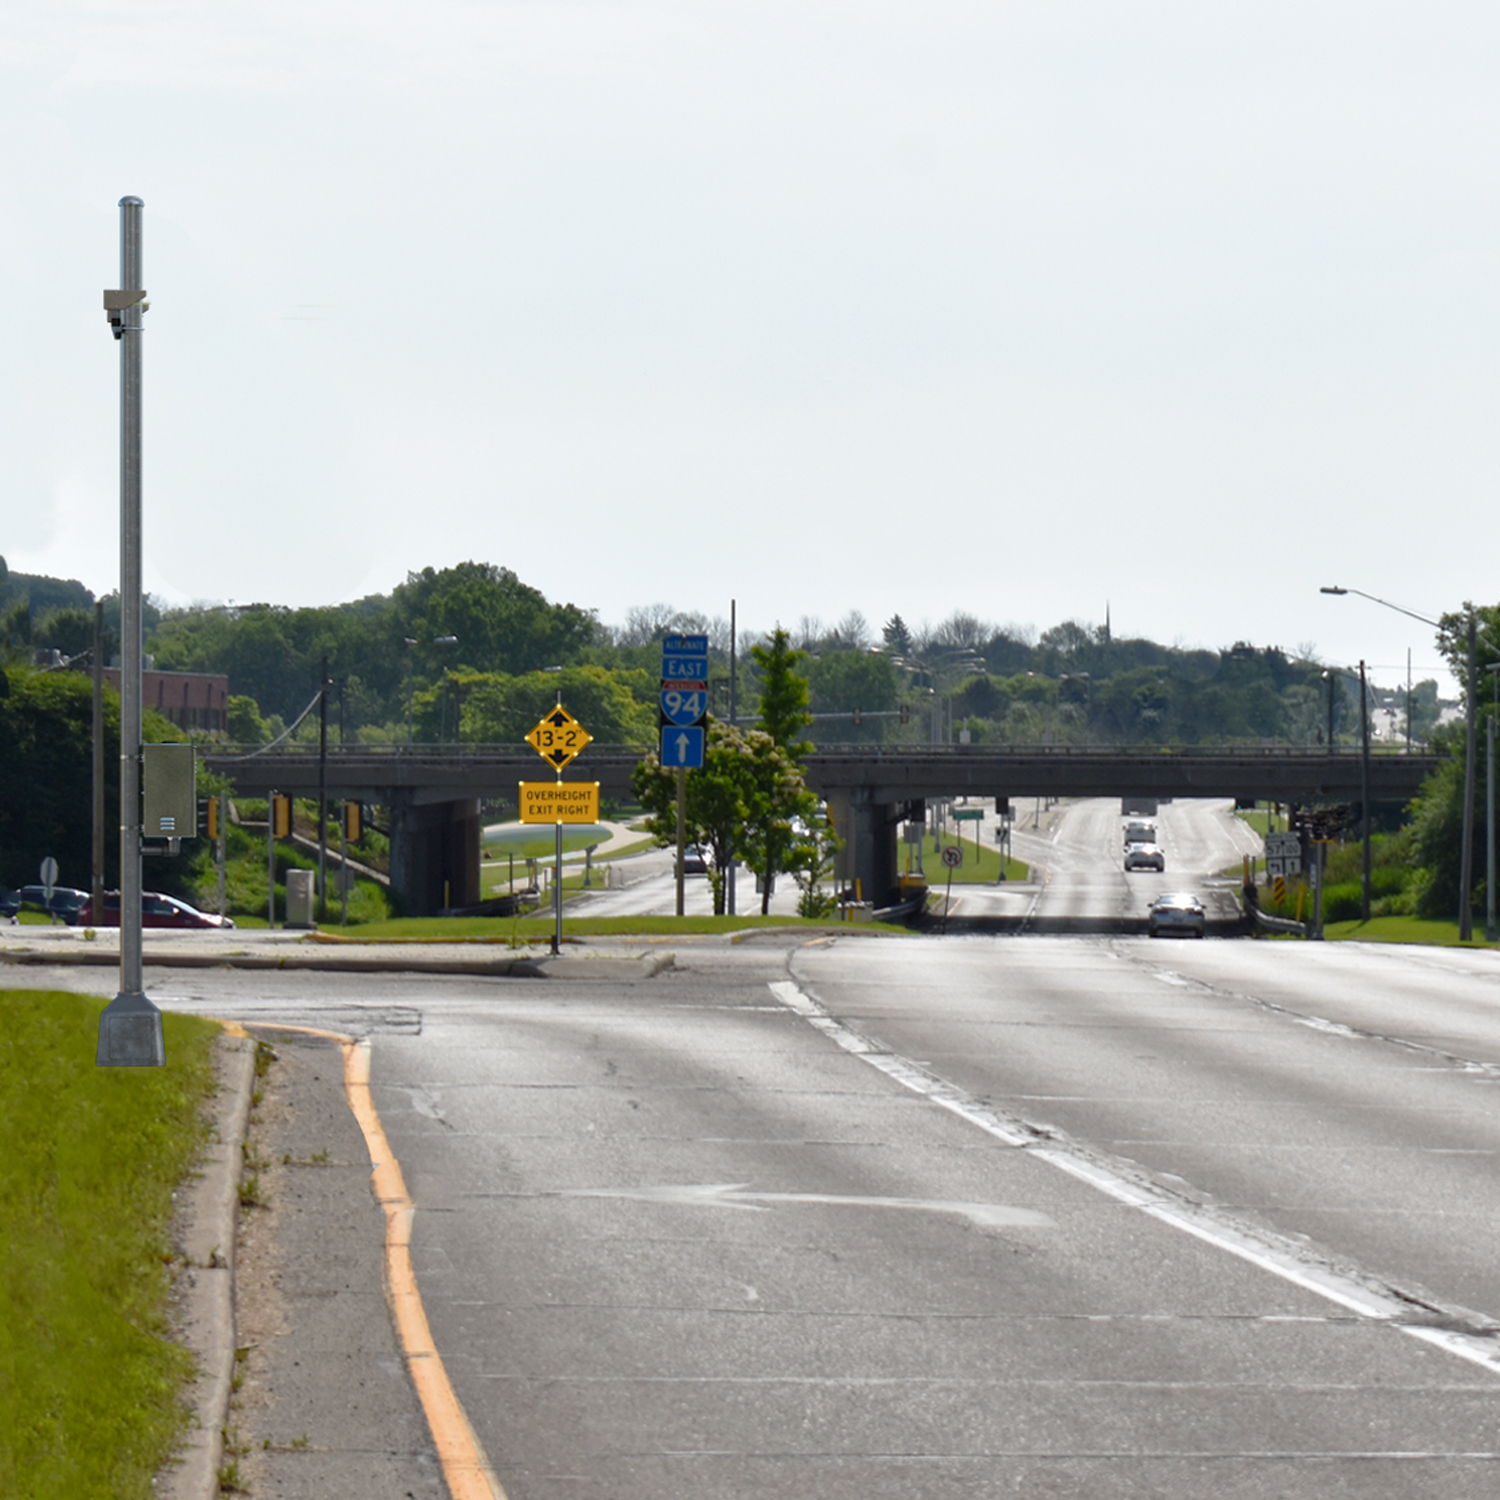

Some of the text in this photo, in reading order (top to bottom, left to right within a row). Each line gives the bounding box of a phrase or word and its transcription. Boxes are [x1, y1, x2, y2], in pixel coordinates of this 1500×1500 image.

[666, 640, 705, 649] ALTNATE
[668, 660, 703, 676] EAST
[665, 692, 700, 717] 94
[526, 791, 592, 800] OVERHEIGHT
[528, 805, 589, 815] EXIT RIGHT
